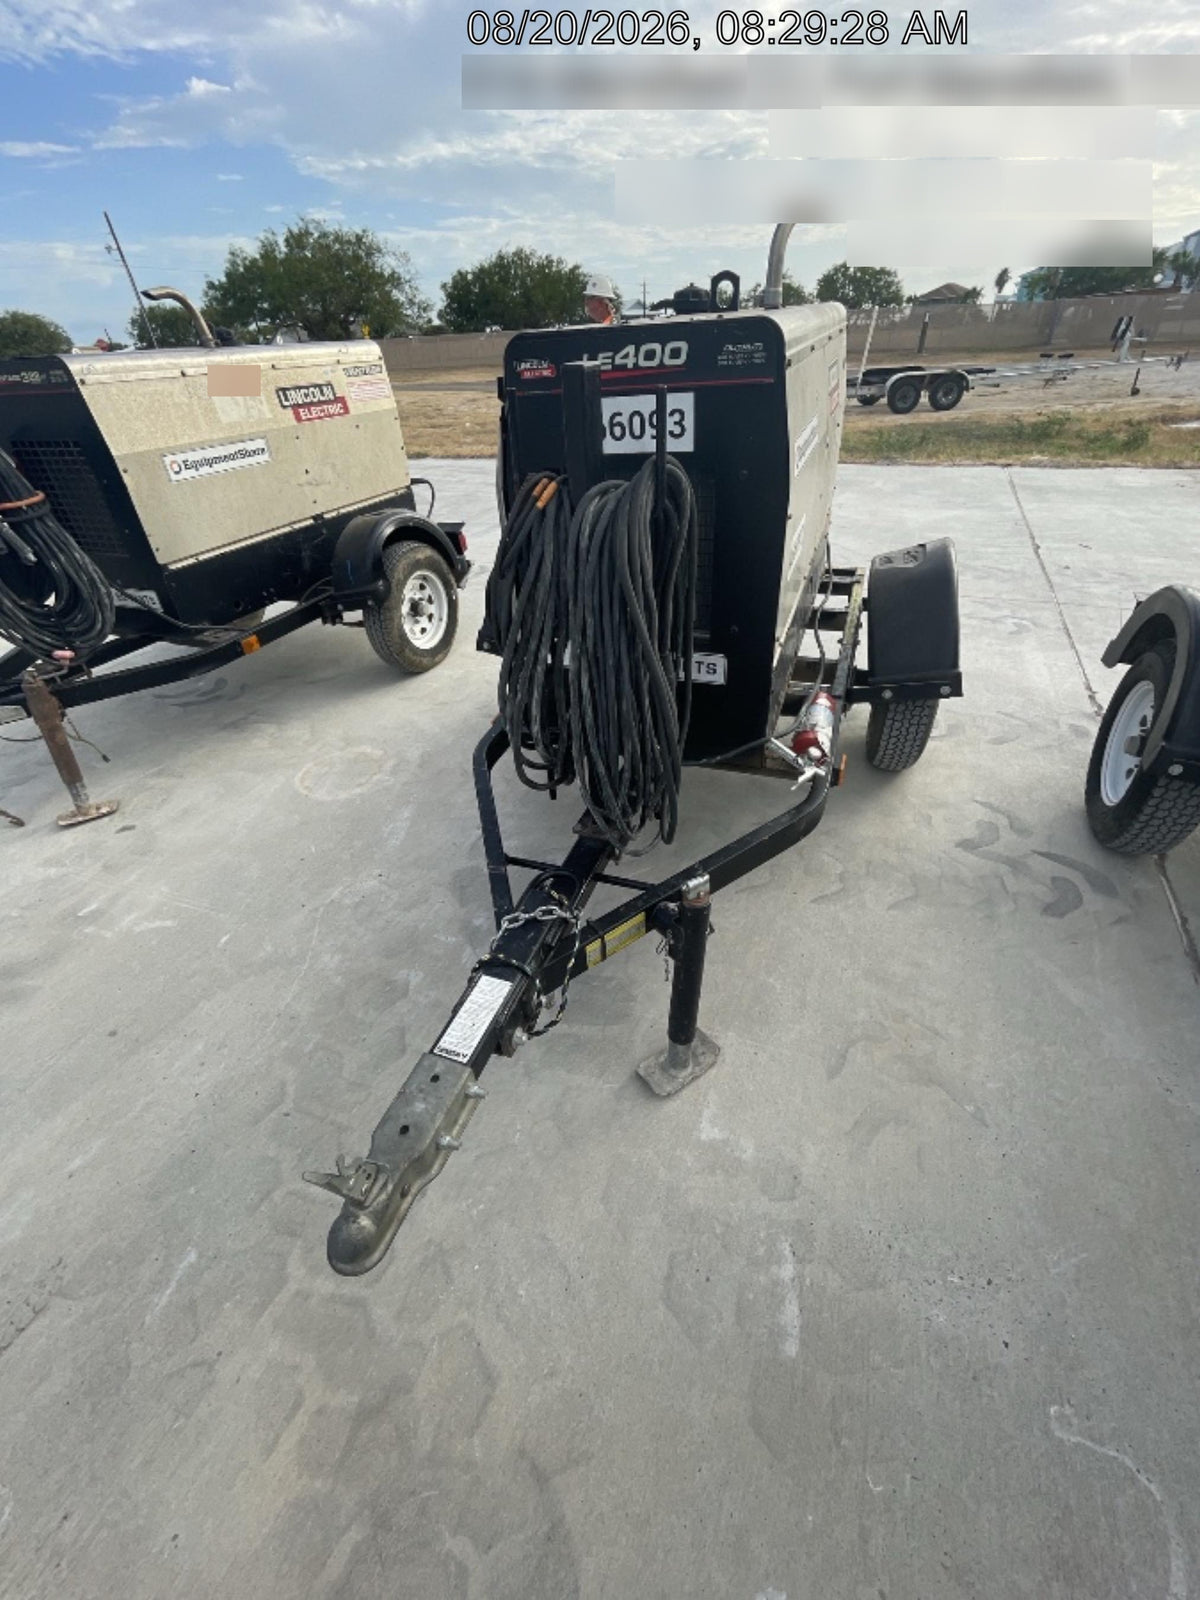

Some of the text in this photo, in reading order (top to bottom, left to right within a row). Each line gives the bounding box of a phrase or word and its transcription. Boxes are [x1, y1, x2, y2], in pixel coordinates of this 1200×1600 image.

[278, 385, 335, 406] LINCOLN
[299, 403, 344, 420] ELECTRIC
[601, 408, 687, 442] 6093
[182, 447, 266, 472] EquipmentShare
[694, 661, 718, 675] TS
